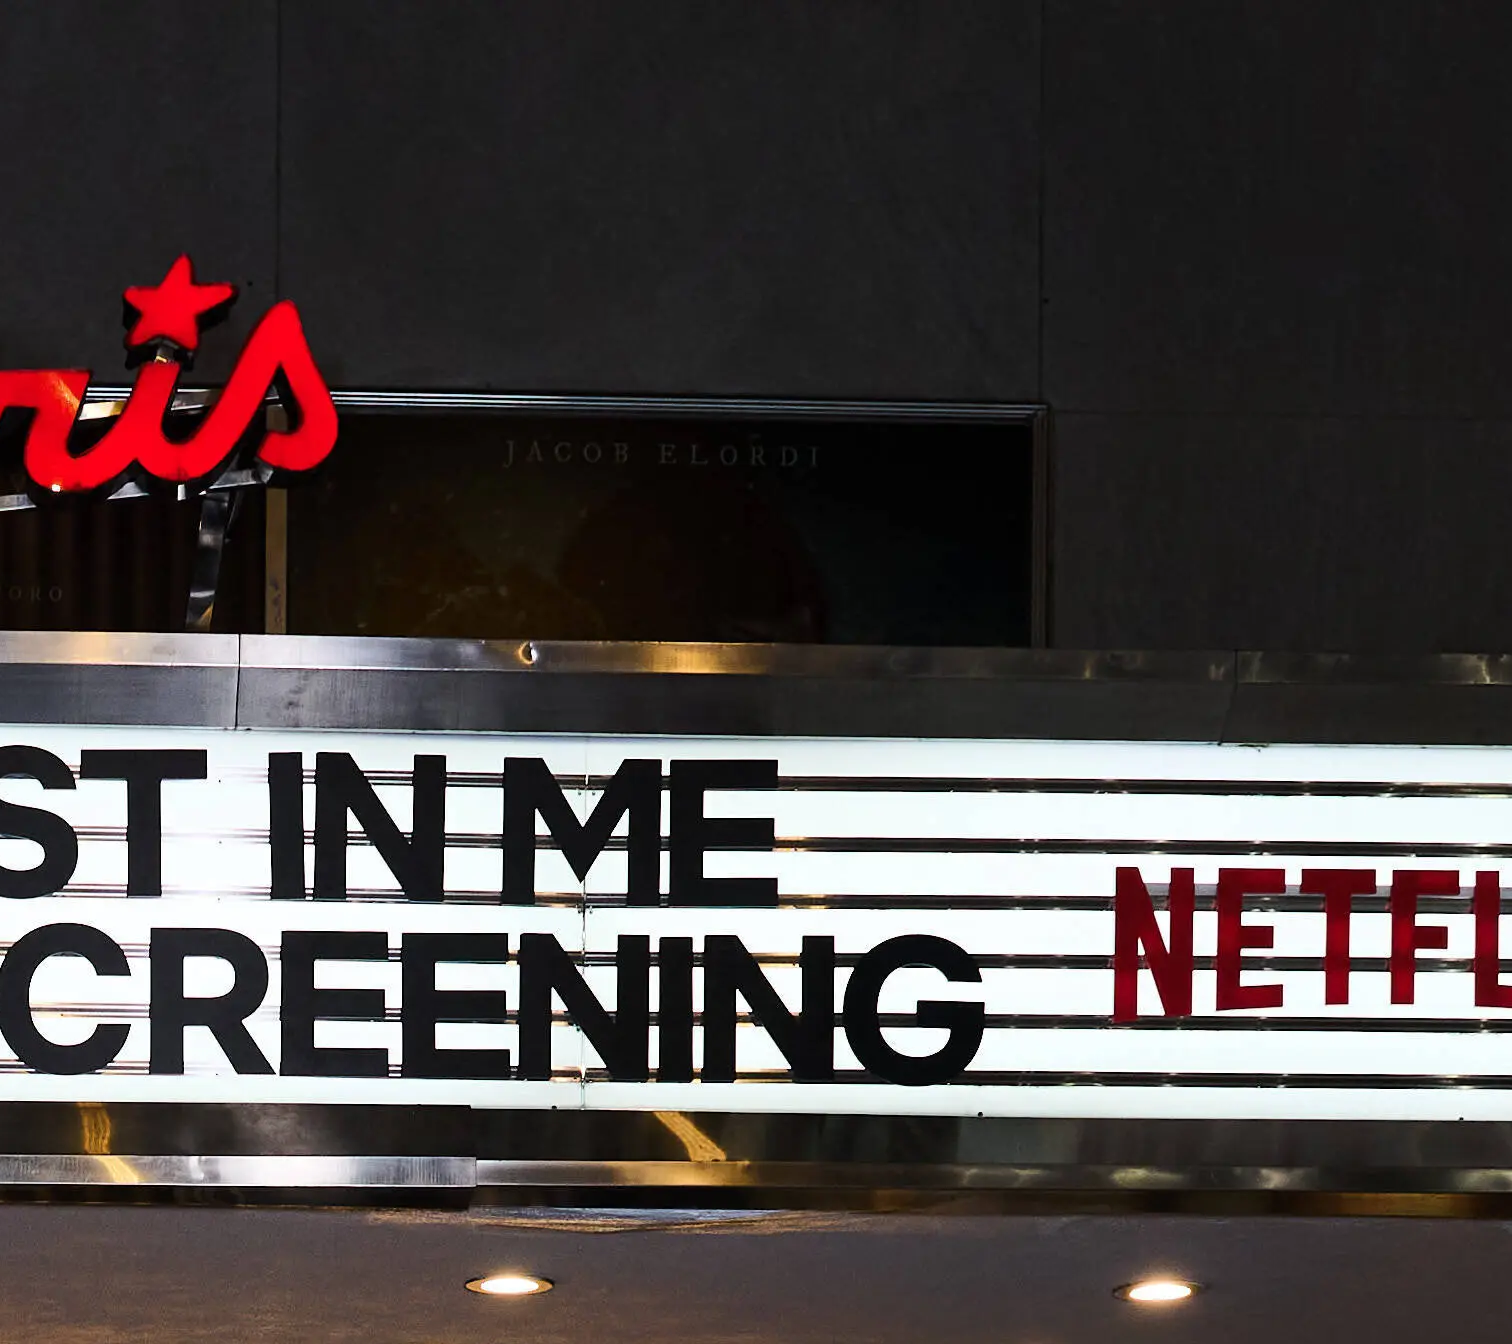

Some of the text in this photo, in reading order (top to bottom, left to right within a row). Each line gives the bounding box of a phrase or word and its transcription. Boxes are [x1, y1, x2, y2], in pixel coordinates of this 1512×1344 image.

[503, 438, 823, 470] JACOB ELORDI
[267, 749, 446, 905] IN
[499, 754, 779, 908] ME
